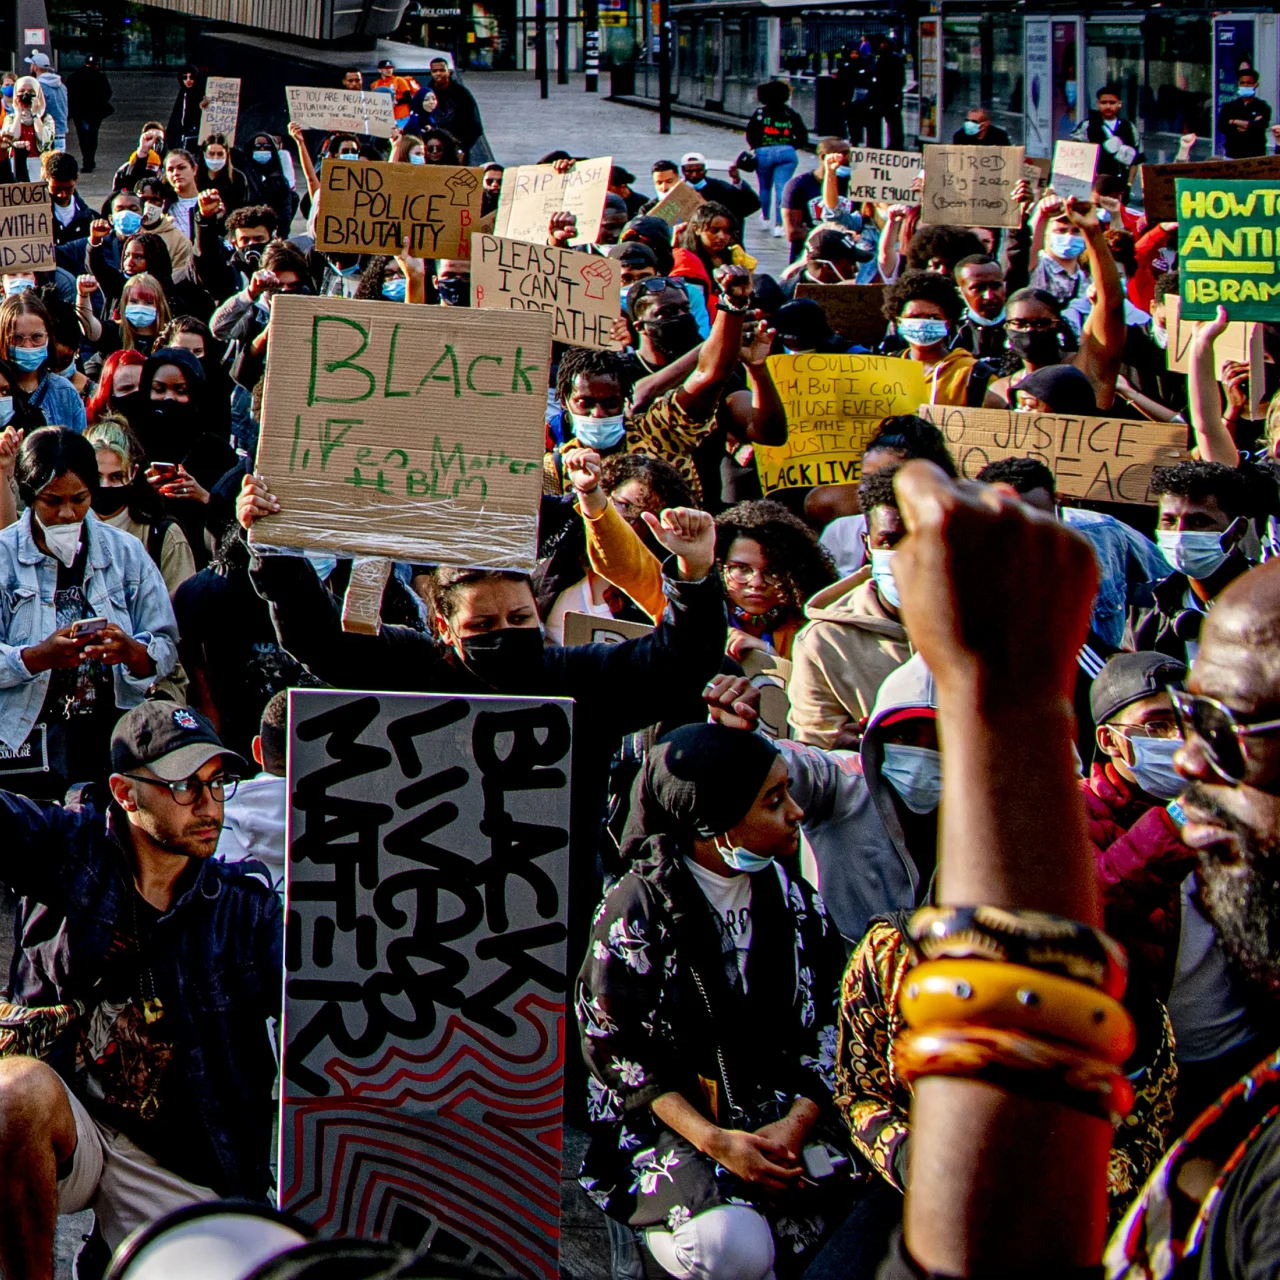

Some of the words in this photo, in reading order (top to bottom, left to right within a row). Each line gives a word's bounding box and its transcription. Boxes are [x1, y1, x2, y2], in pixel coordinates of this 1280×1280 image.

[306, 90, 320, 101] YOU
[324, 92, 339, 100] ARE
[866, 152, 921, 169] FREEDOM
[329, 165, 383, 192] END
[516, 173, 554, 195] RIP
[870, 167, 892, 181] TIL
[353, 190, 446, 223] POLICE
[1180, 190, 1256, 219] HOW
[38, 212, 49, 234] A
[323, 215, 446, 252] BRUTALITY
[481, 235, 574, 281] PLEASE
[498, 269, 512, 292] I
[792, 355, 888, 372] COULDNT
[845, 378, 860, 395] I
[806, 400, 837, 417] USE
[843, 397, 897, 418] EVERY
[925, 407, 966, 443] NO
[993, 409, 1143, 459] JUSTICE
[760, 462, 813, 491] LACK
[817, 460, 863, 485] LIVE
